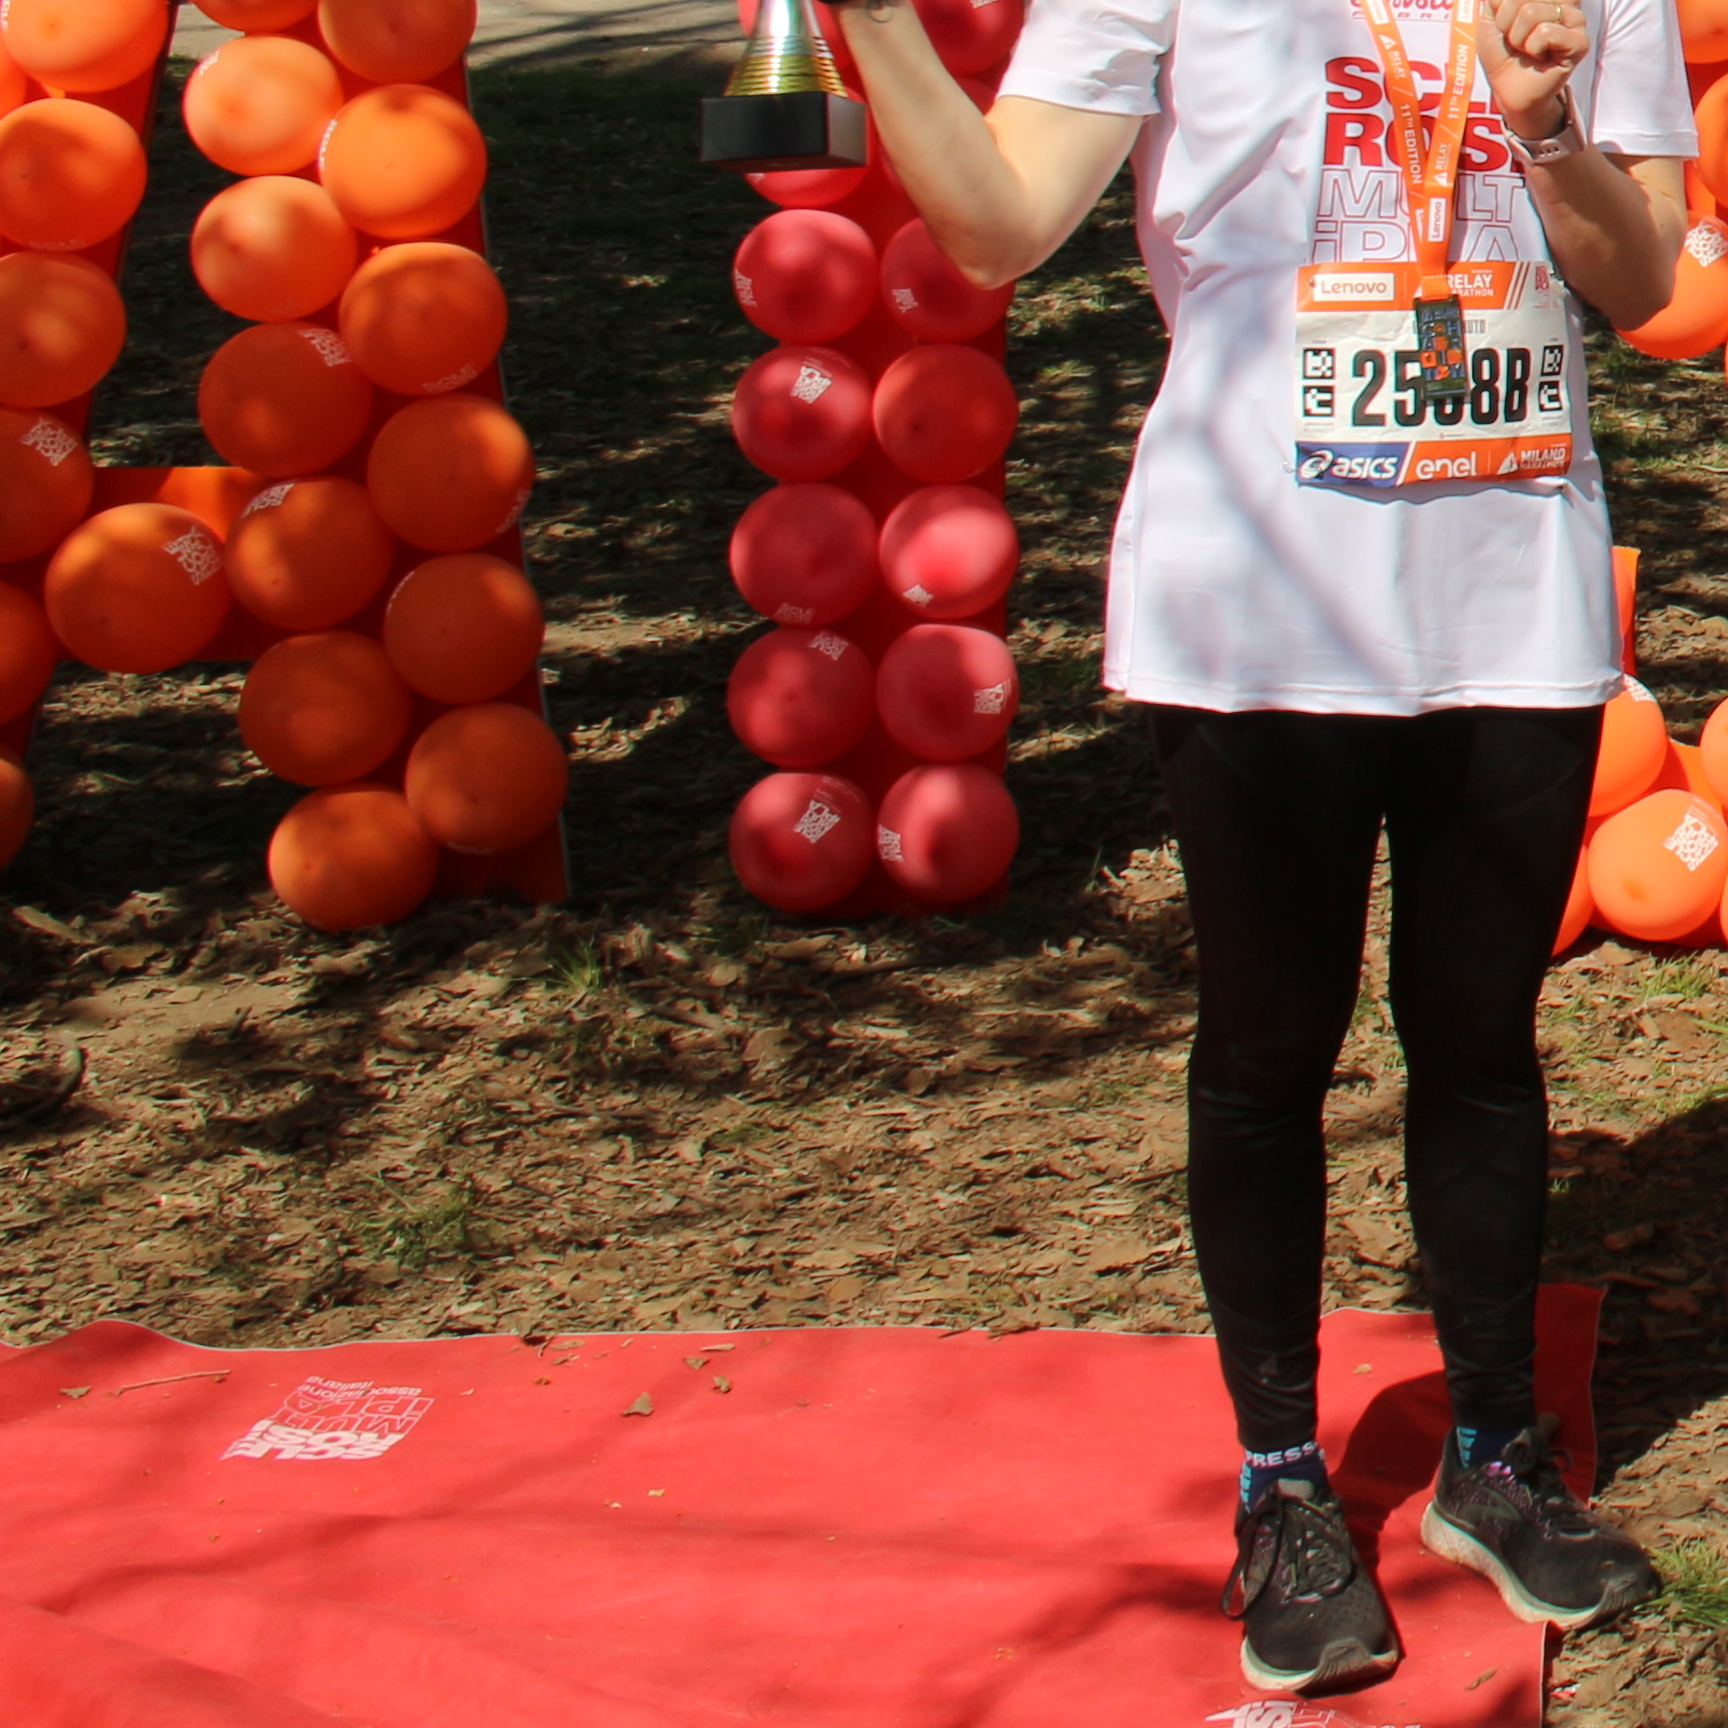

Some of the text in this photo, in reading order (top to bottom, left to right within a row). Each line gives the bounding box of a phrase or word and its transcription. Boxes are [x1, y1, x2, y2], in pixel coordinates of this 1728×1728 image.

[1318, 168, 1525, 222] MLT
[1312, 220, 1519, 262] iPA
[1320, 280, 1387, 294] Lenovo
[1451, 288, 1494, 297] ARATHON
[1352, 348, 1531, 427] 258B
[1416, 452, 1477, 477] enel
[1520, 447, 1566, 462] MILANO
